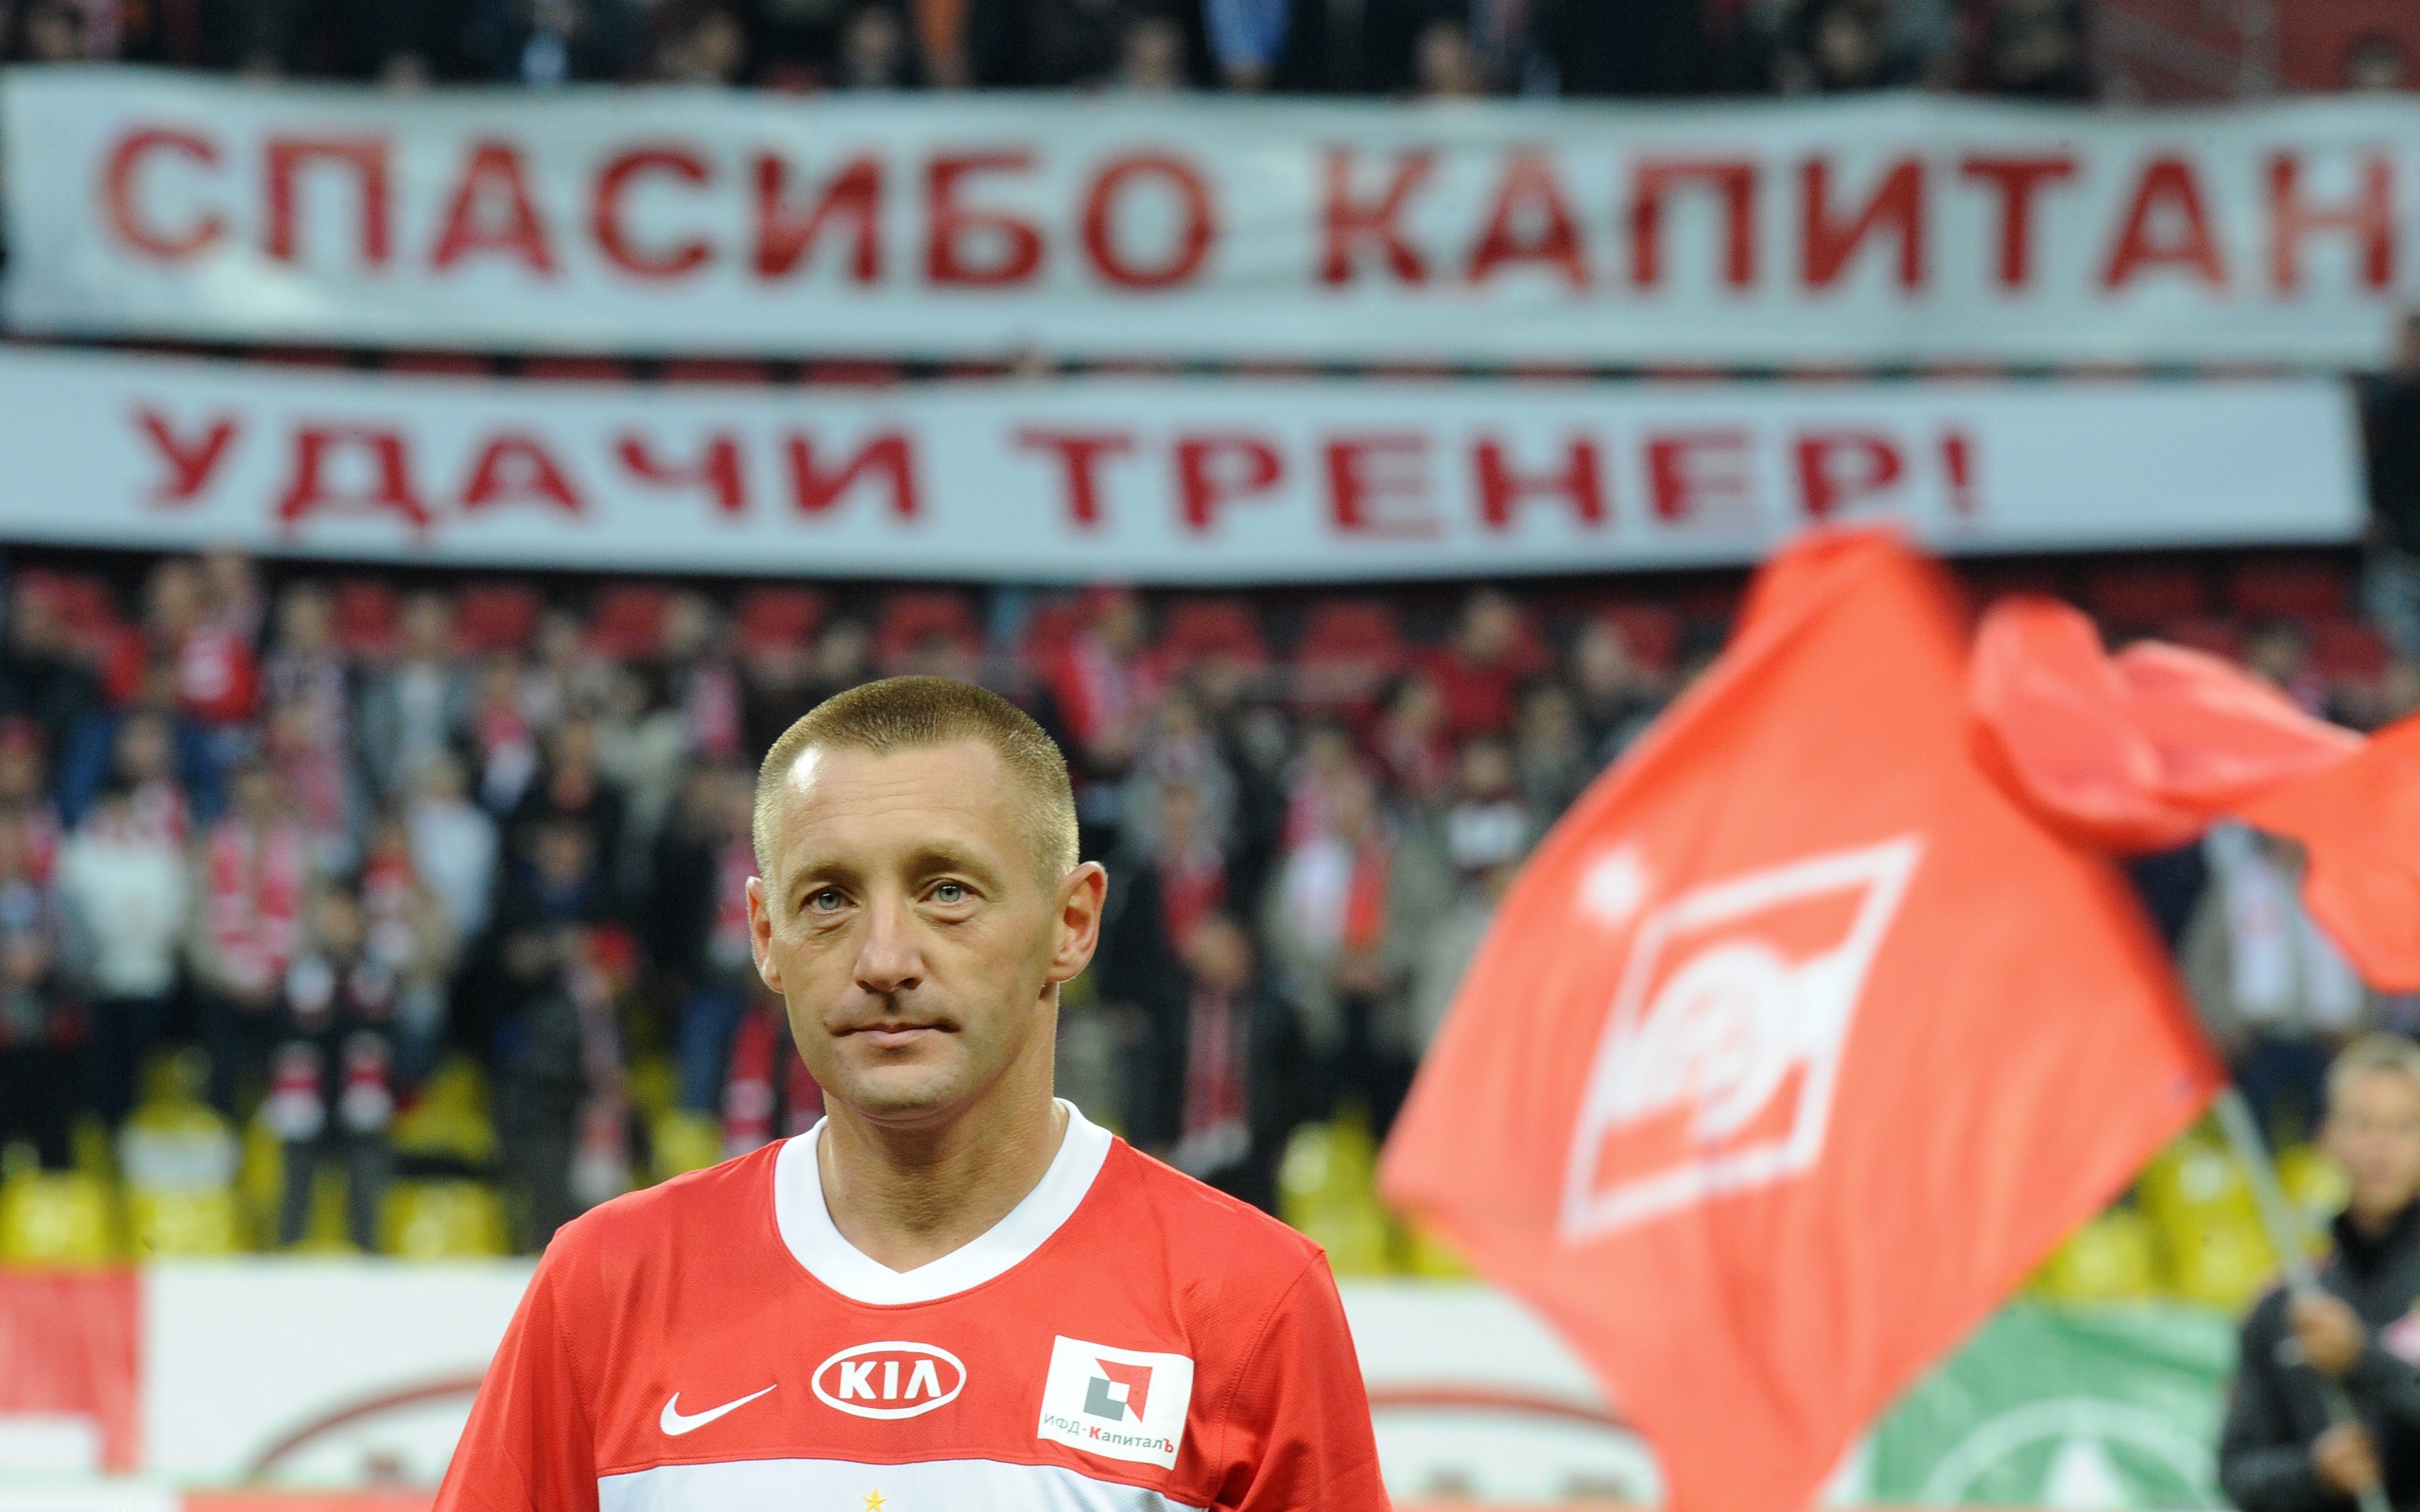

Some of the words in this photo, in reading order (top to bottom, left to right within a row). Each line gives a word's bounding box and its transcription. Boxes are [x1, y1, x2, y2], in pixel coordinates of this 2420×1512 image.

[98, 127, 1219, 291] СПАСИБО
[1318, 147, 2397, 295] КАПИТАН
[130, 404, 921, 542] УДАЧИ
[1013, 427, 1985, 541] ТРЕНЕР!
[837, 1360, 943, 1400] KIA
